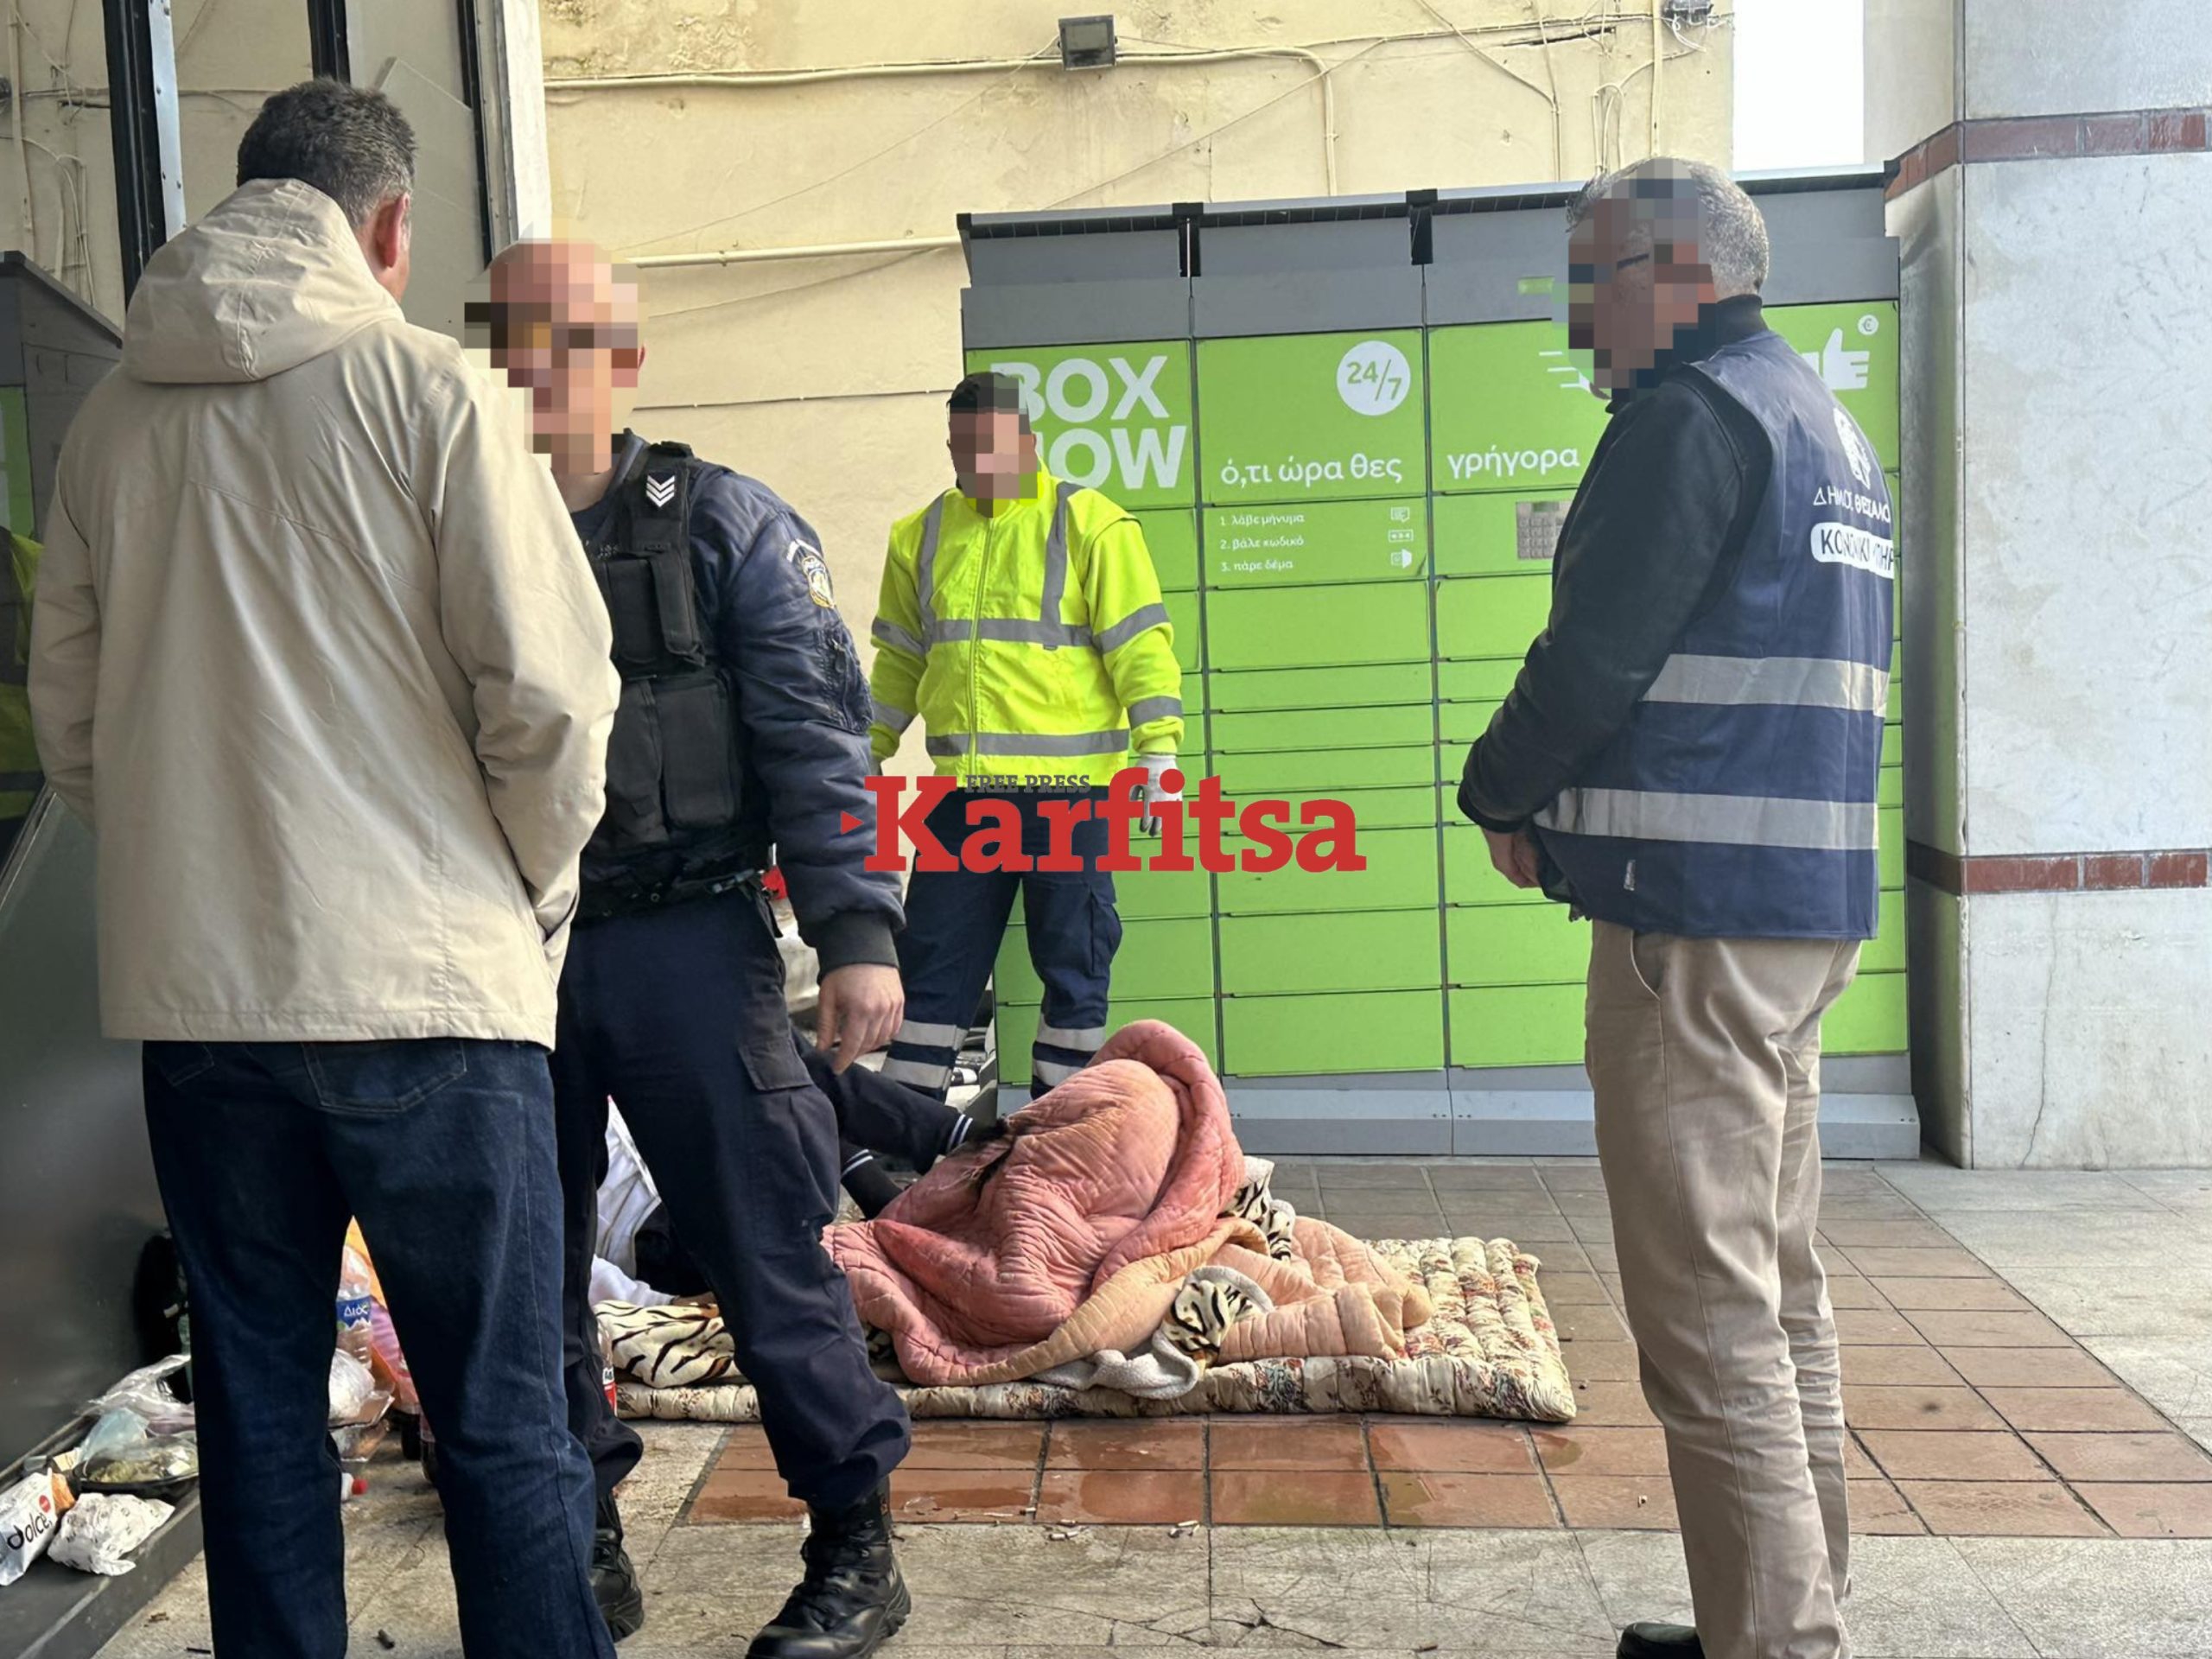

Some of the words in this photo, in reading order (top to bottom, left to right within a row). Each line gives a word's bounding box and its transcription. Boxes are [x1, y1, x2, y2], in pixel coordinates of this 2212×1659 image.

[1346, 342, 1402, 402] 24/7
[1036, 426, 1187, 489] OW
[1220, 459, 1272, 489] ό,τι
[1278, 454, 1344, 487] ώρα
[1350, 453, 1402, 484] θες
[1447, 444, 1580, 480] γρήγορα
[1230, 514, 1260, 526] λάβε
[1261, 513, 1306, 525] μήνυμα
[1220, 539, 1230, 550] 2.
[1232, 538, 1262, 551] βάλε
[1220, 562, 1231, 572] 3.
[1234, 560, 1263, 573] πάρε
[1264, 559, 1294, 570] δέμα
